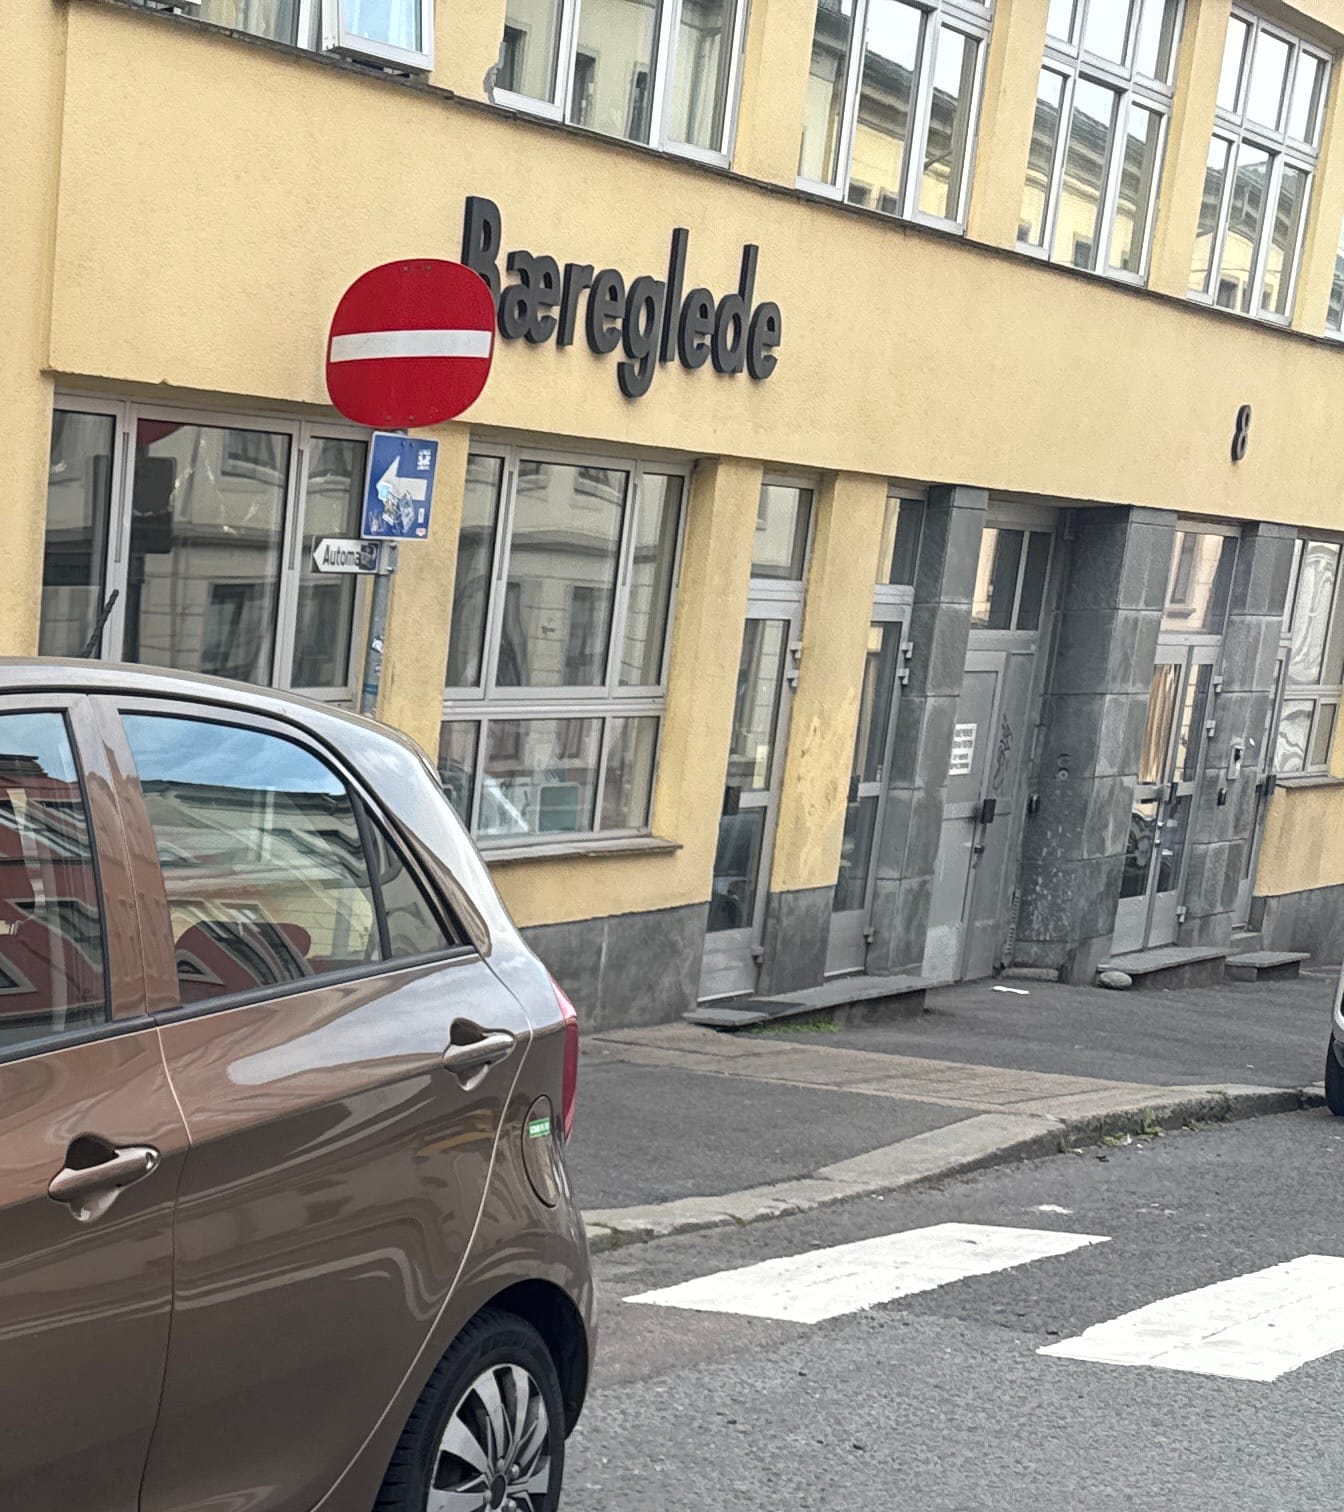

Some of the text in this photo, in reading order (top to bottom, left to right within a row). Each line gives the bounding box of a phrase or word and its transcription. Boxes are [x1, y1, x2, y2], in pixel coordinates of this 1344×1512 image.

[461, 196, 781, 398] Bæreglede
[1231, 405, 1252, 461] 8
[322, 544, 364, 567] Automa
